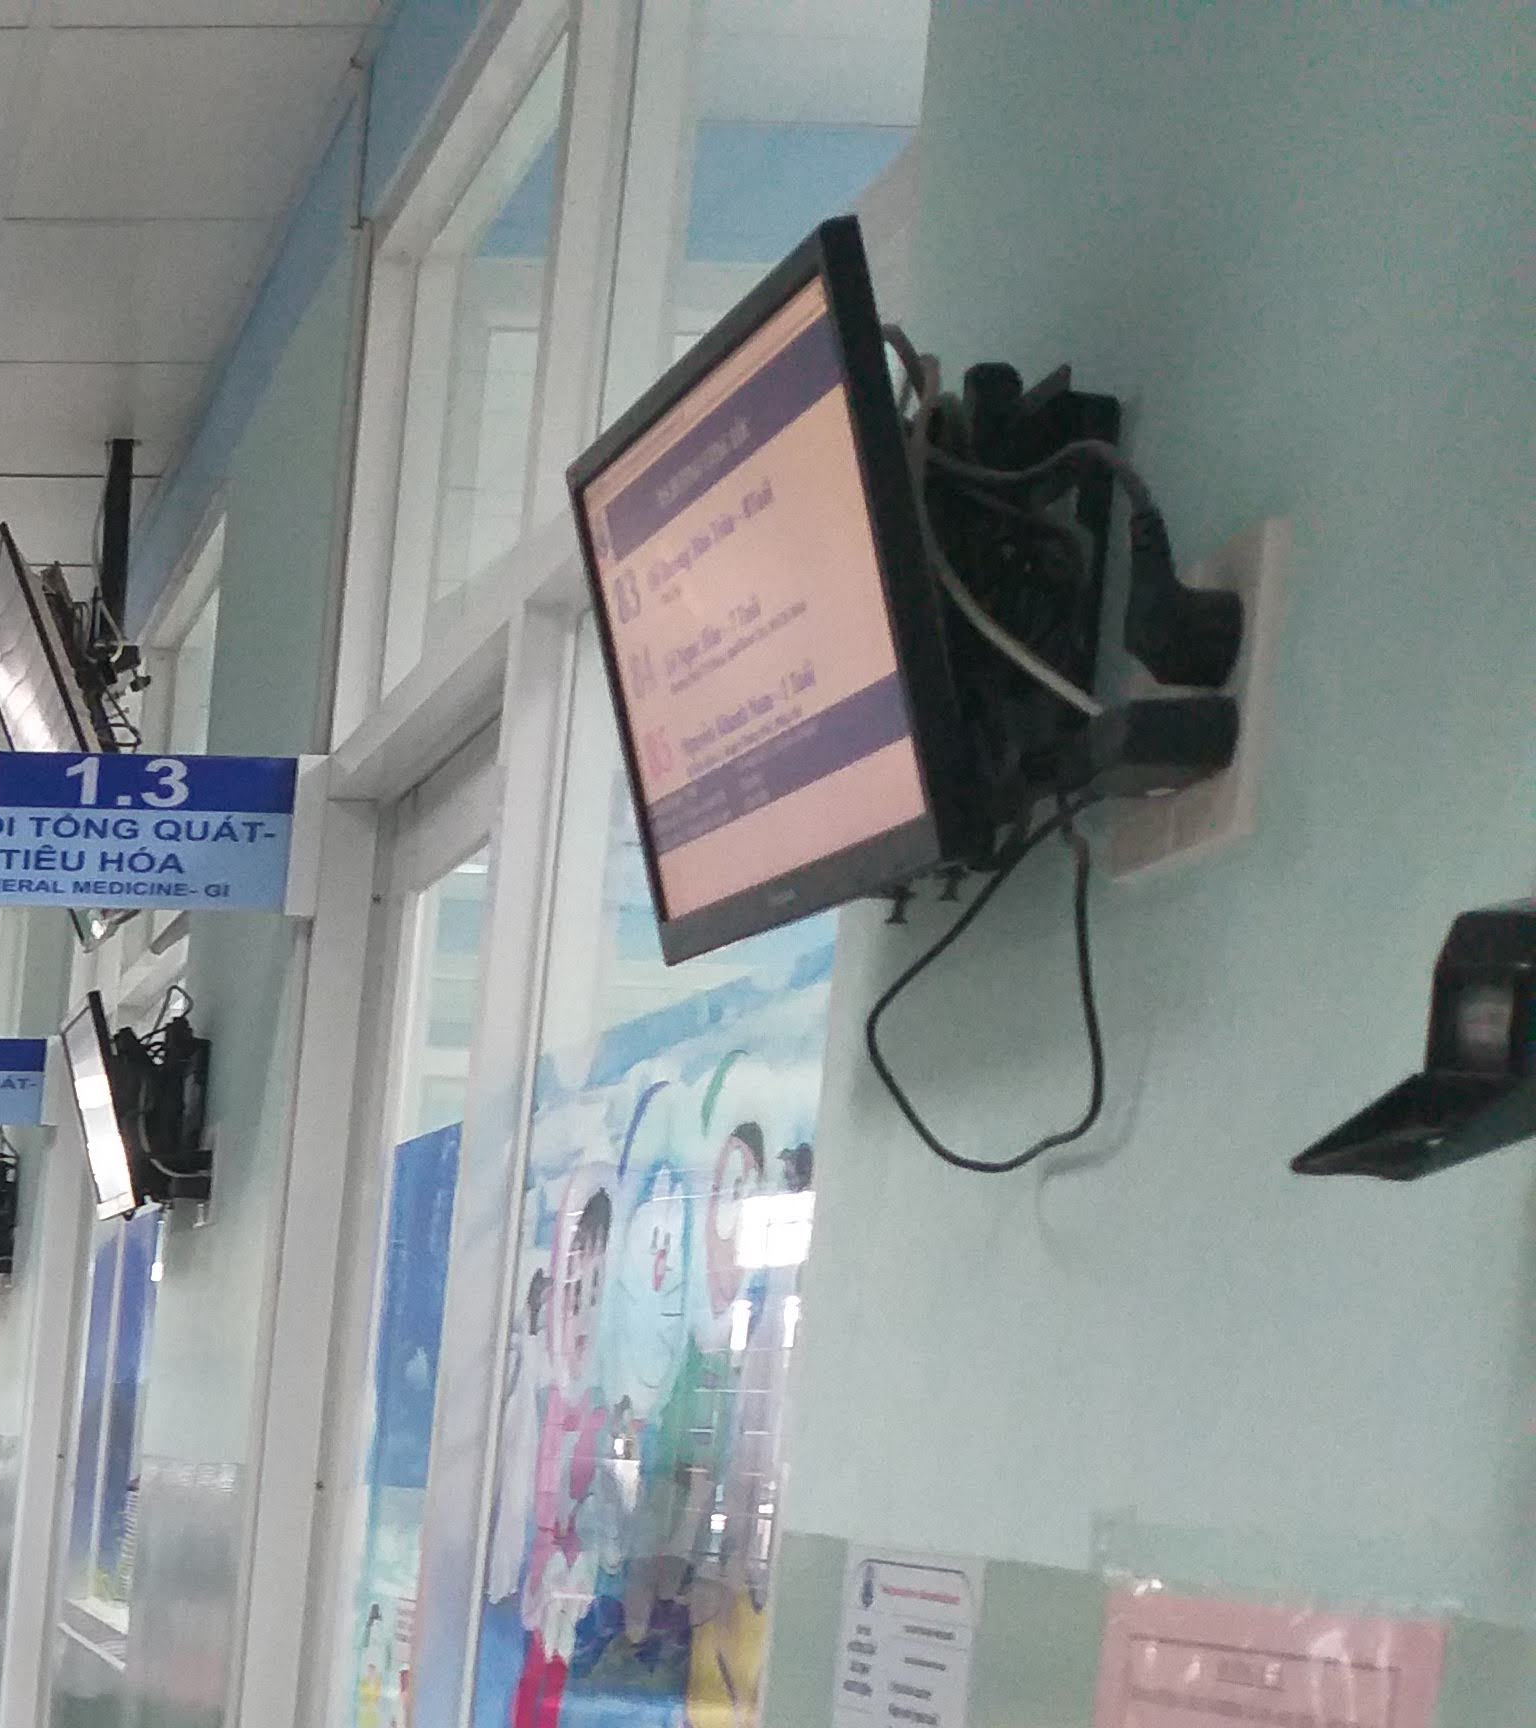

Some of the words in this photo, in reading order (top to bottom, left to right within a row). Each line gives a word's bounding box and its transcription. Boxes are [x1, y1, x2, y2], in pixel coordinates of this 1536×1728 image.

[65, 756, 190, 807] 1.3
[30, 812, 138, 841] TỔNG
[0, 845, 85, 872] TIÊU
[101, 847, 184, 874] HÓA
[204, 883, 231, 898] GI
